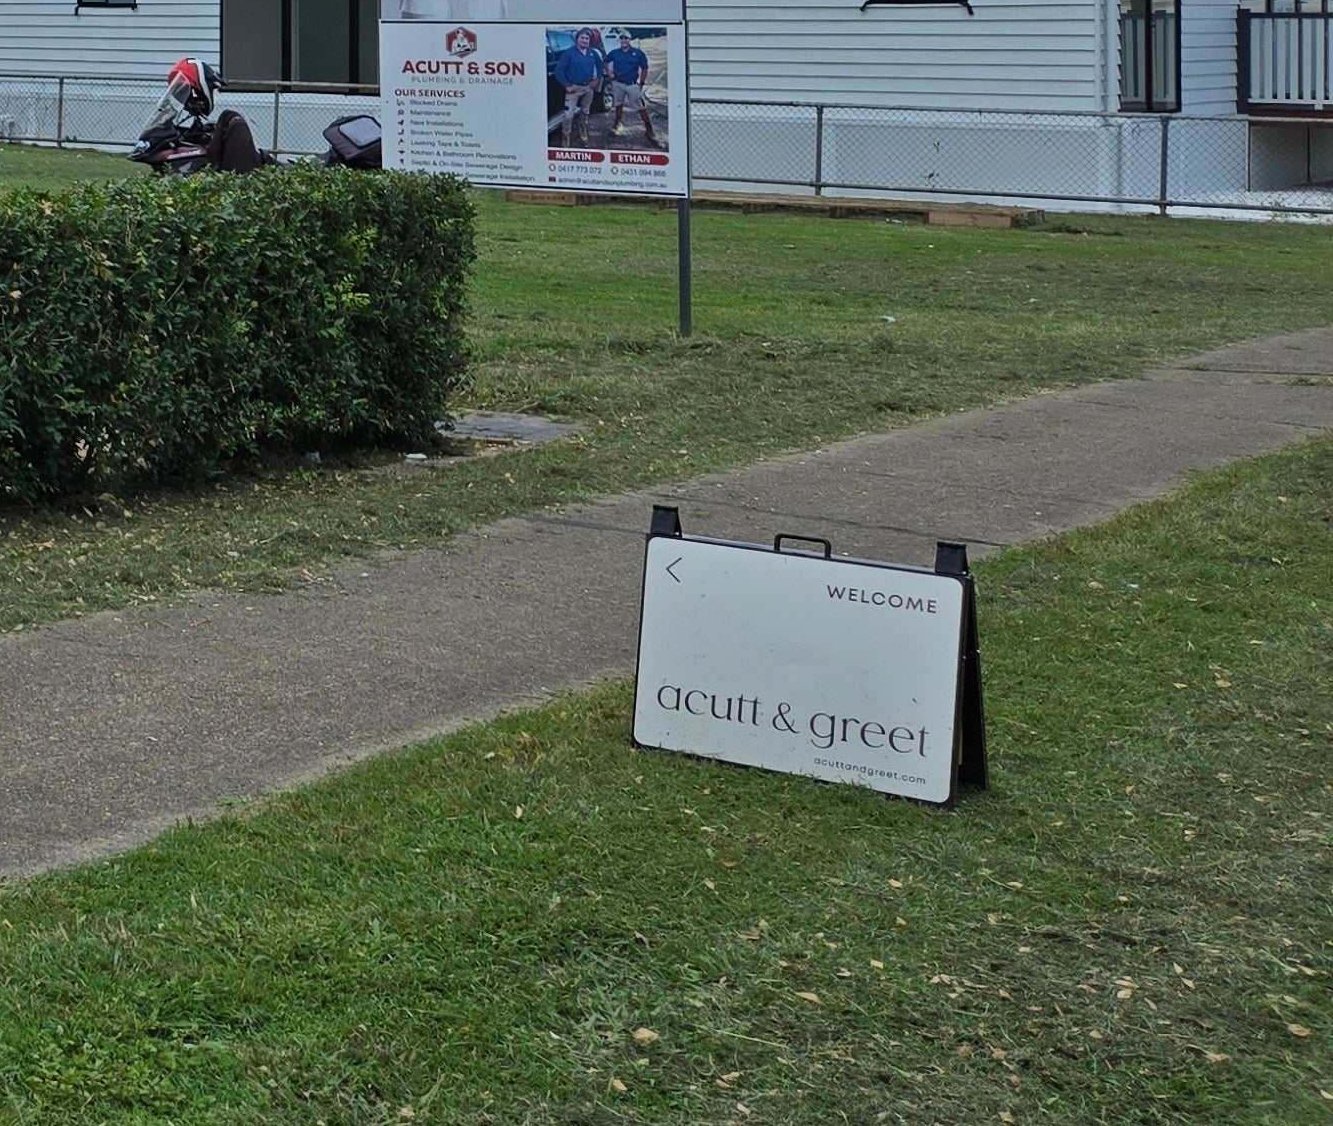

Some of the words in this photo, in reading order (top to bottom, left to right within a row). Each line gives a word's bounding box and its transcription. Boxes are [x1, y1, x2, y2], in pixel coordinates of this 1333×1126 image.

[402, 60, 464, 75] ACUTT
[467, 61, 480, 75] &
[484, 62, 525, 76] SON
[411, 76, 457, 84] PLUMBING
[469, 77, 514, 85] DRAINAGE
[394, 88, 417, 97] OUR
[418, 89, 466, 98] SERVICES
[410, 109, 451, 117] Maintenance
[426, 120, 464, 128] Installations
[410, 140, 436, 148] Leaking
[443, 150, 474, 158] Bathroom
[475, 152, 517, 161] Renovations
[555, 151, 592, 161] MARTIN
[618, 154, 651, 164] ETHAN
[826, 583, 938, 615] WELCOME
[656, 683, 761, 728] acutt
[771, 701, 800, 735] &
[808, 711, 930, 758] greet
[813, 757, 927, 785] acuttandgreet.com
